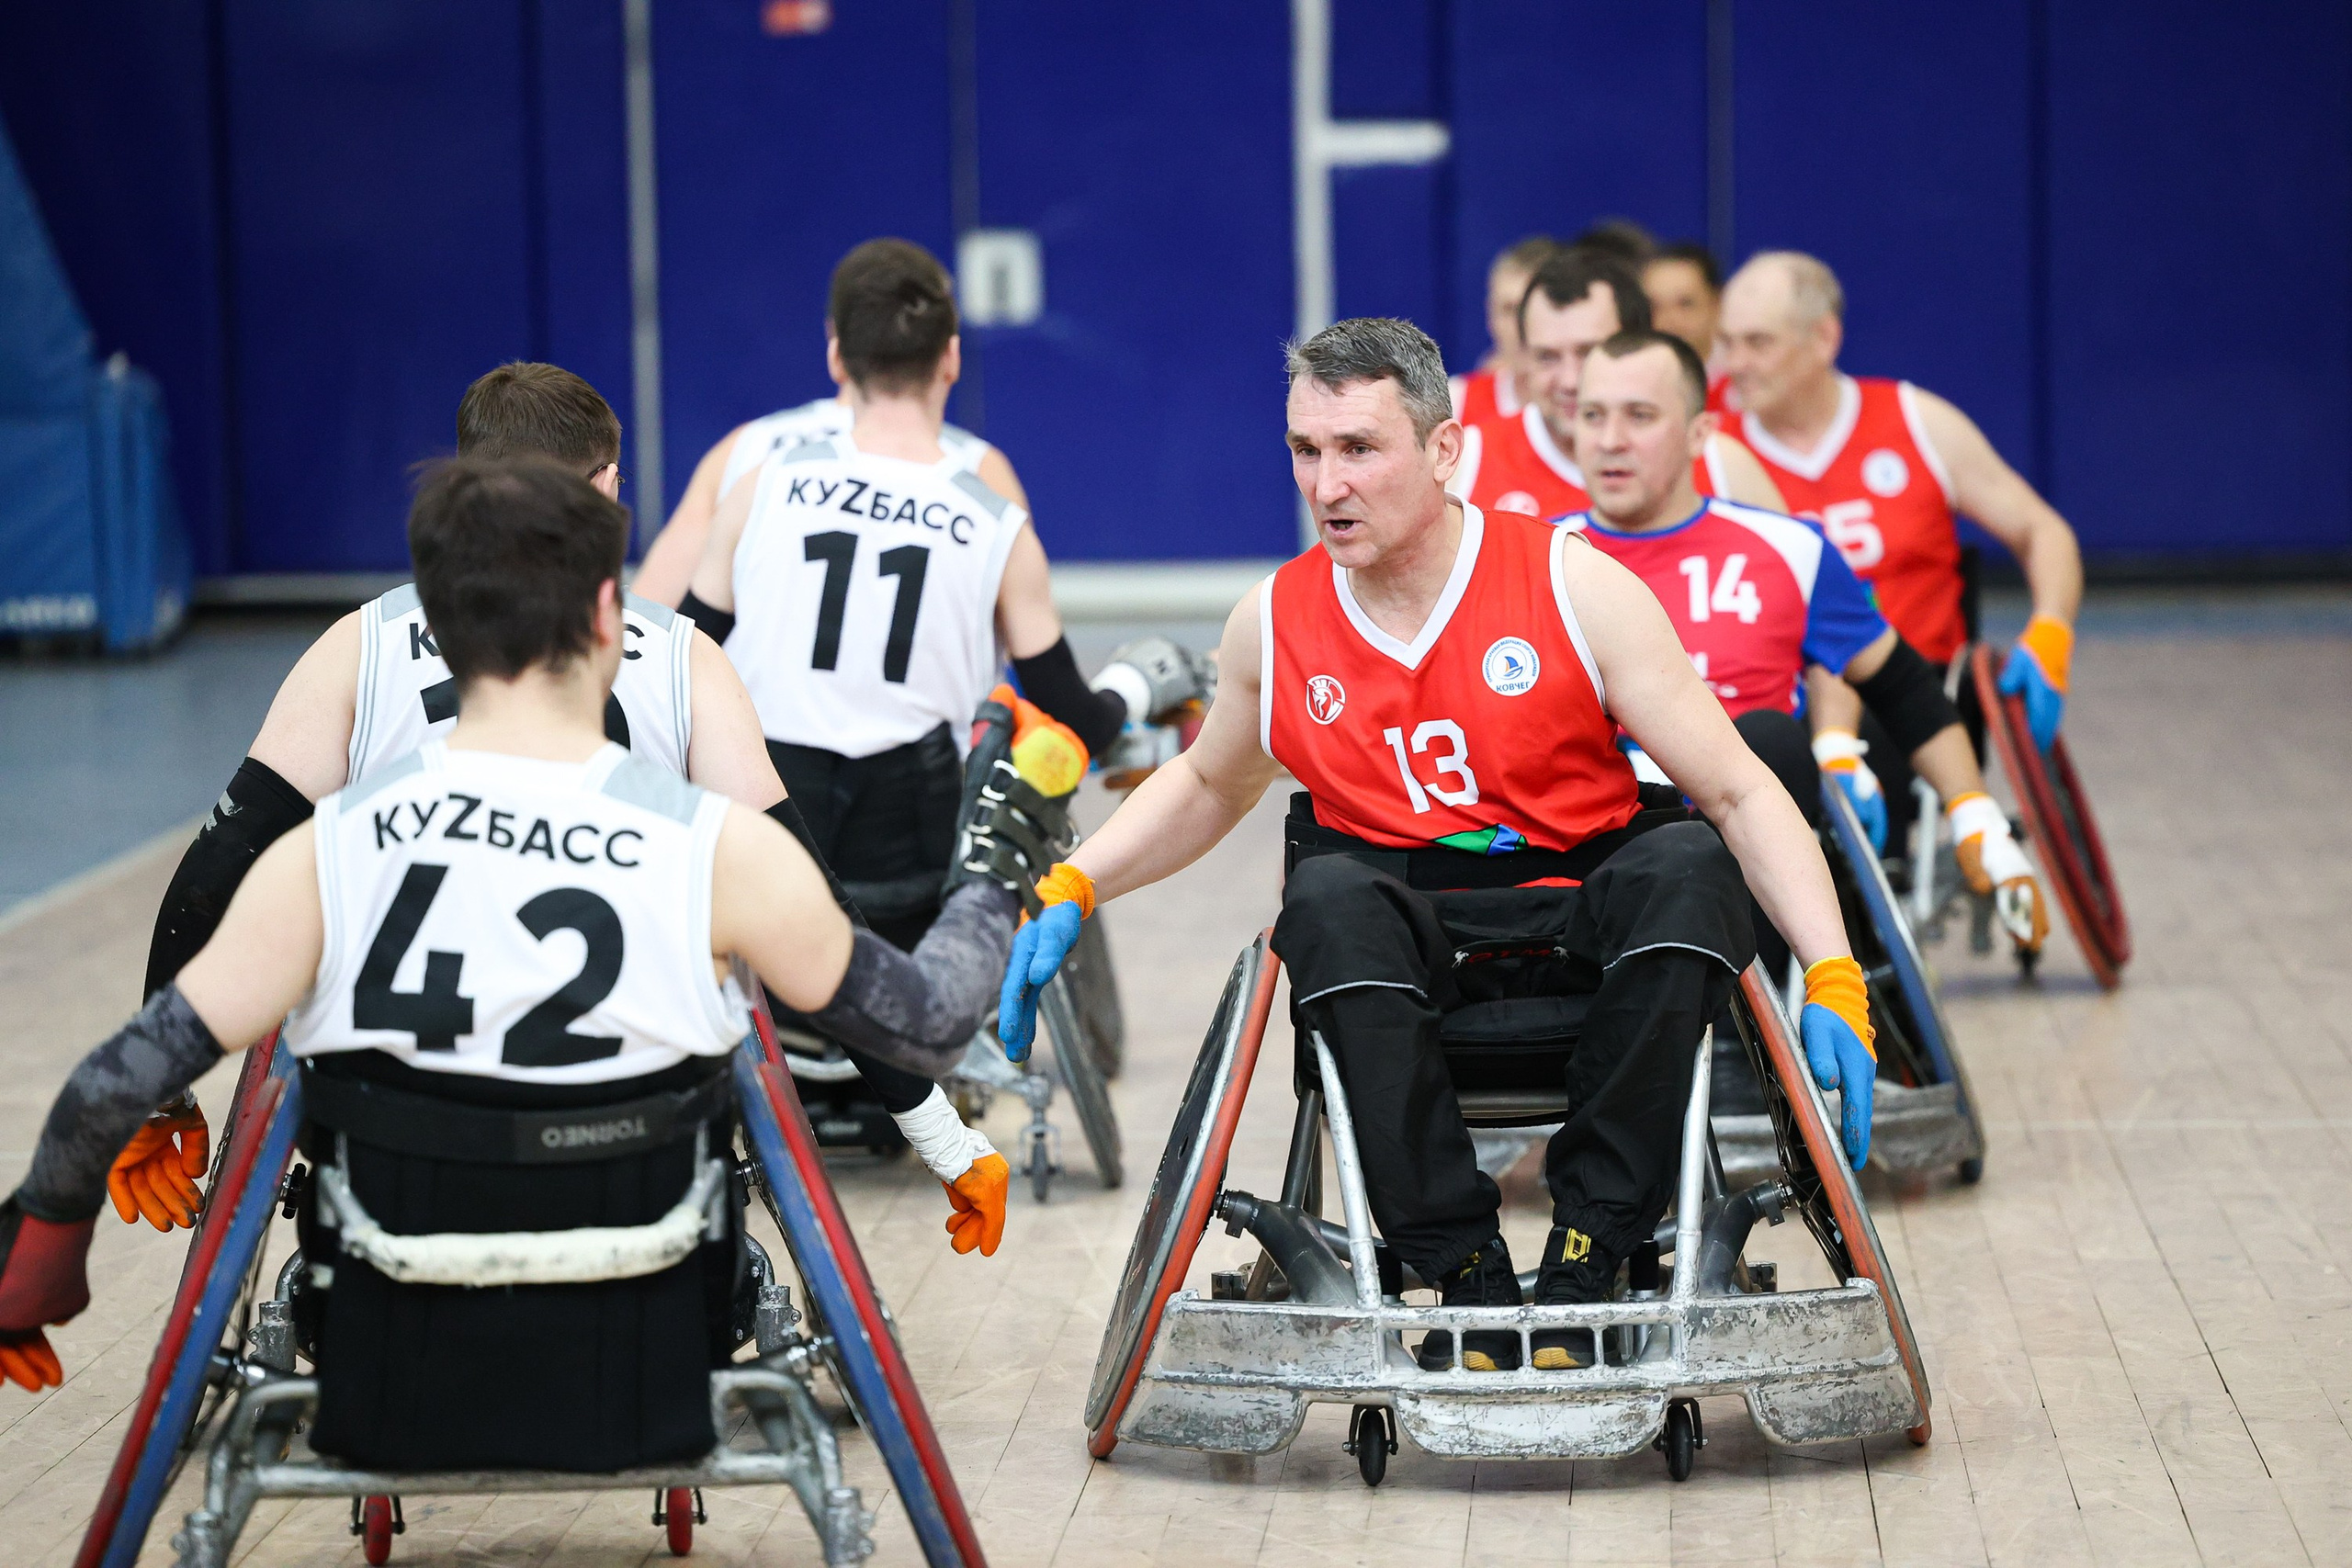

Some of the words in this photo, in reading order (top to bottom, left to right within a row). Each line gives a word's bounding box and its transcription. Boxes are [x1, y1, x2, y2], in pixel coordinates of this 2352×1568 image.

[1795, 498, 1884, 570] 5
[804, 530, 931, 683] 11
[1679, 553, 1762, 625] 14
[1496, 682, 1530, 692] КОВЧЕГ
[1383, 718, 1479, 814] 13
[353, 863, 624, 1068] 42
